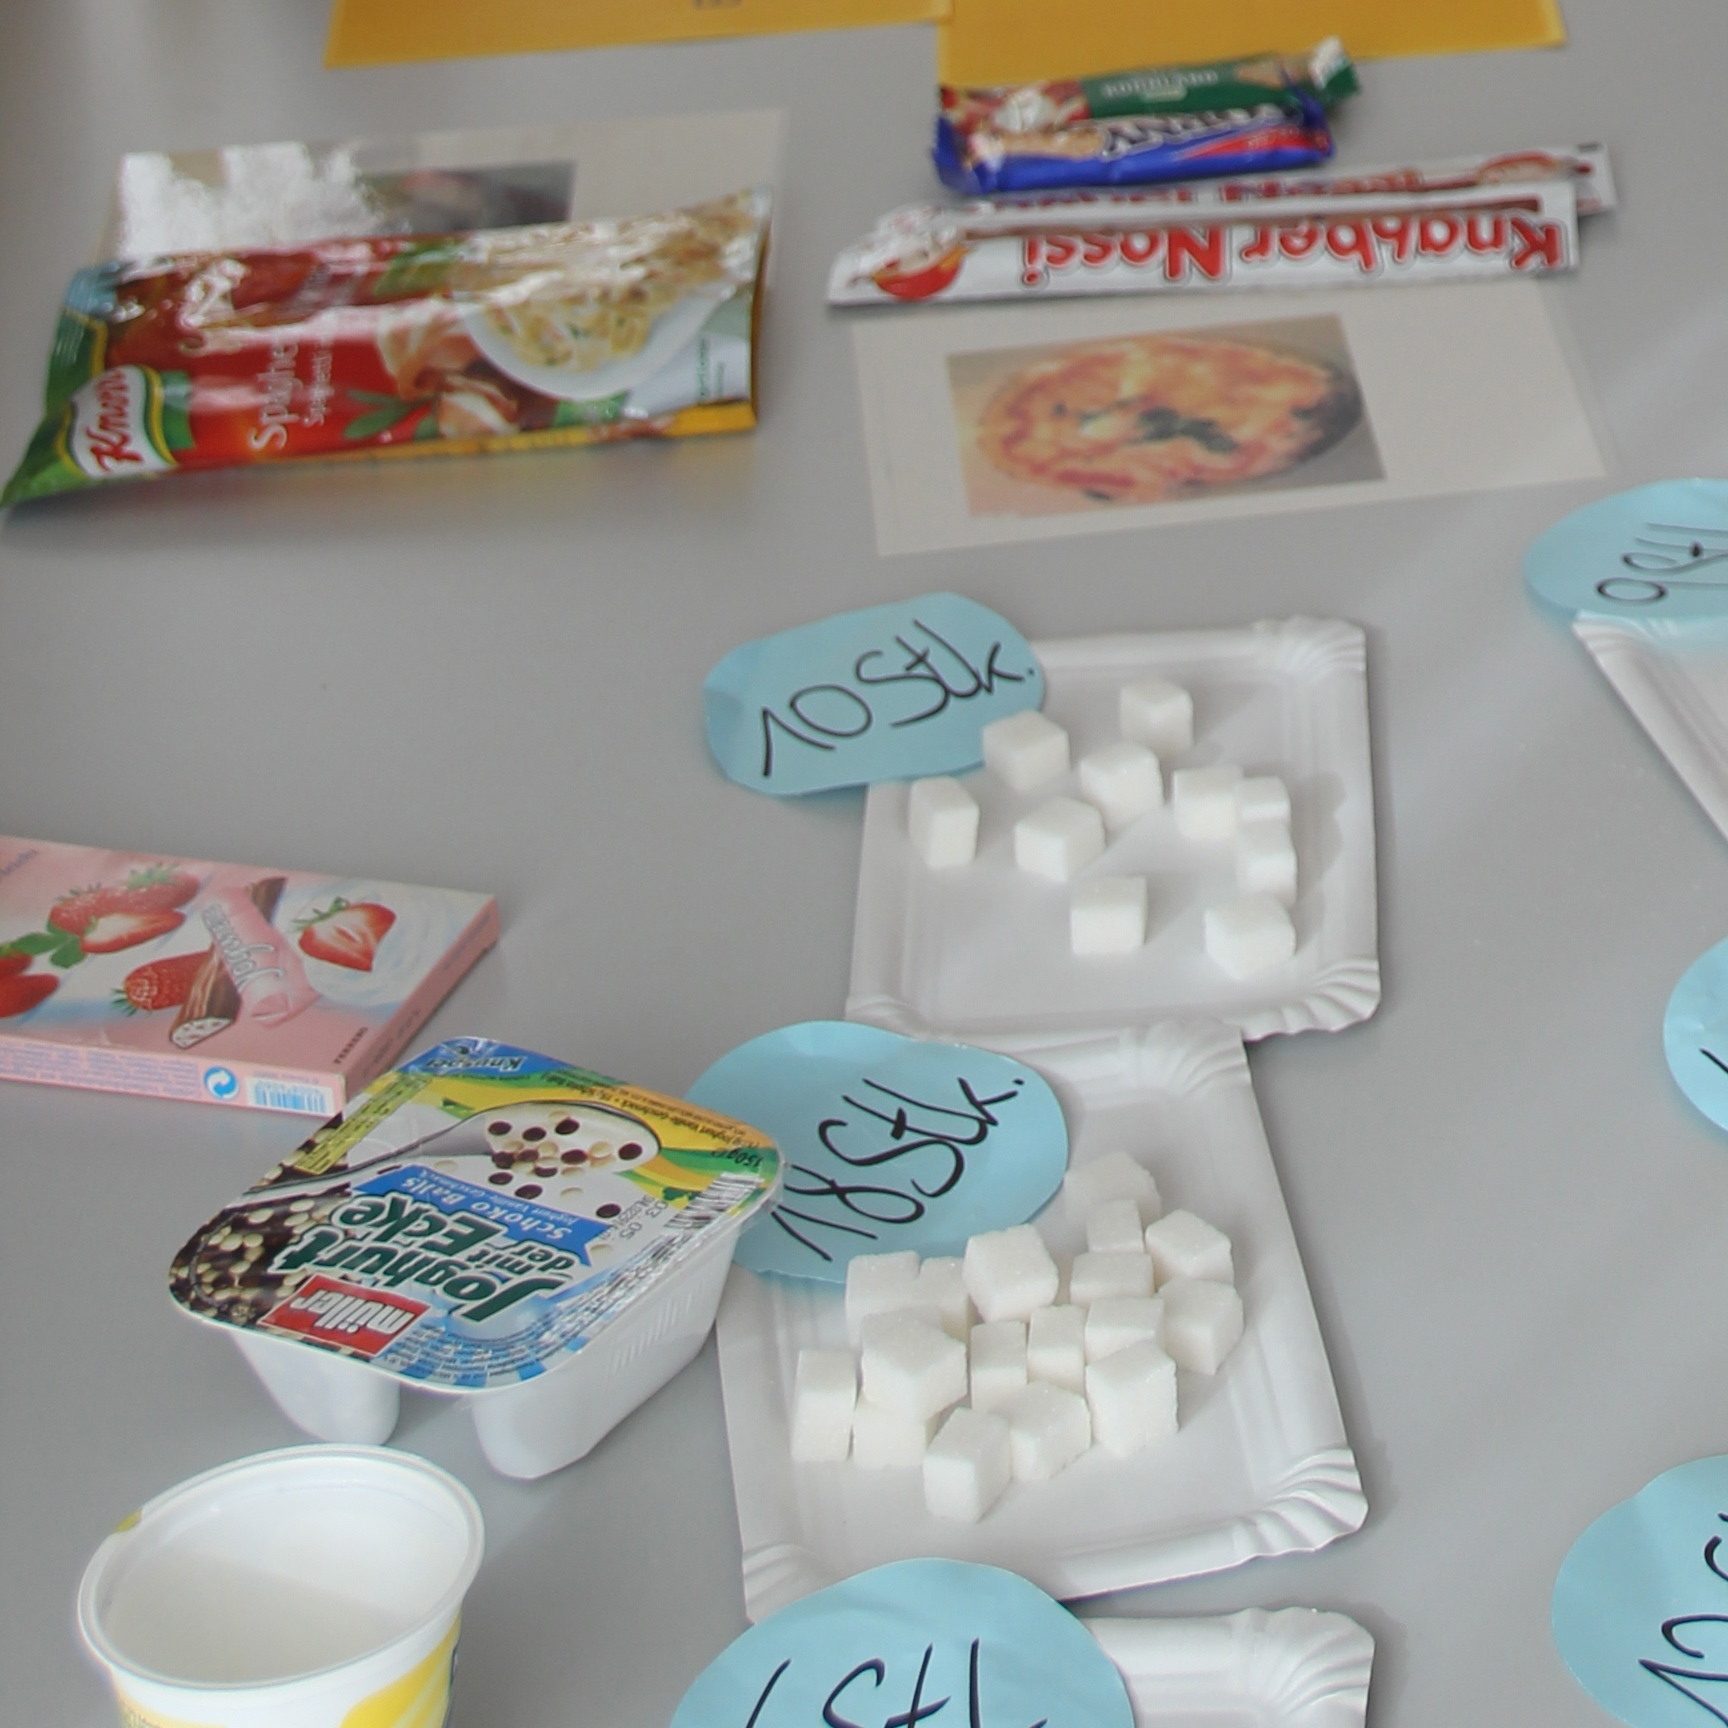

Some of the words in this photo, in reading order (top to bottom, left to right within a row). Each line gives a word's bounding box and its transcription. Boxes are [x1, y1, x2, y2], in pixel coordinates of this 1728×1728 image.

[1022, 223, 1228, 286] Nossi
[1240, 211, 1562, 271] Knabber
[86, 368, 143, 472] Knorr
[402, 1176, 454, 1206] Balls
[338, 1196, 504, 1259] Ecke
[470, 1200, 573, 1242] Schoko
[270, 1227, 568, 1323] Joghurt
[466, 1244, 529, 1276] mit
[512, 1240, 576, 1272] der
[290, 1288, 415, 1334] müller
